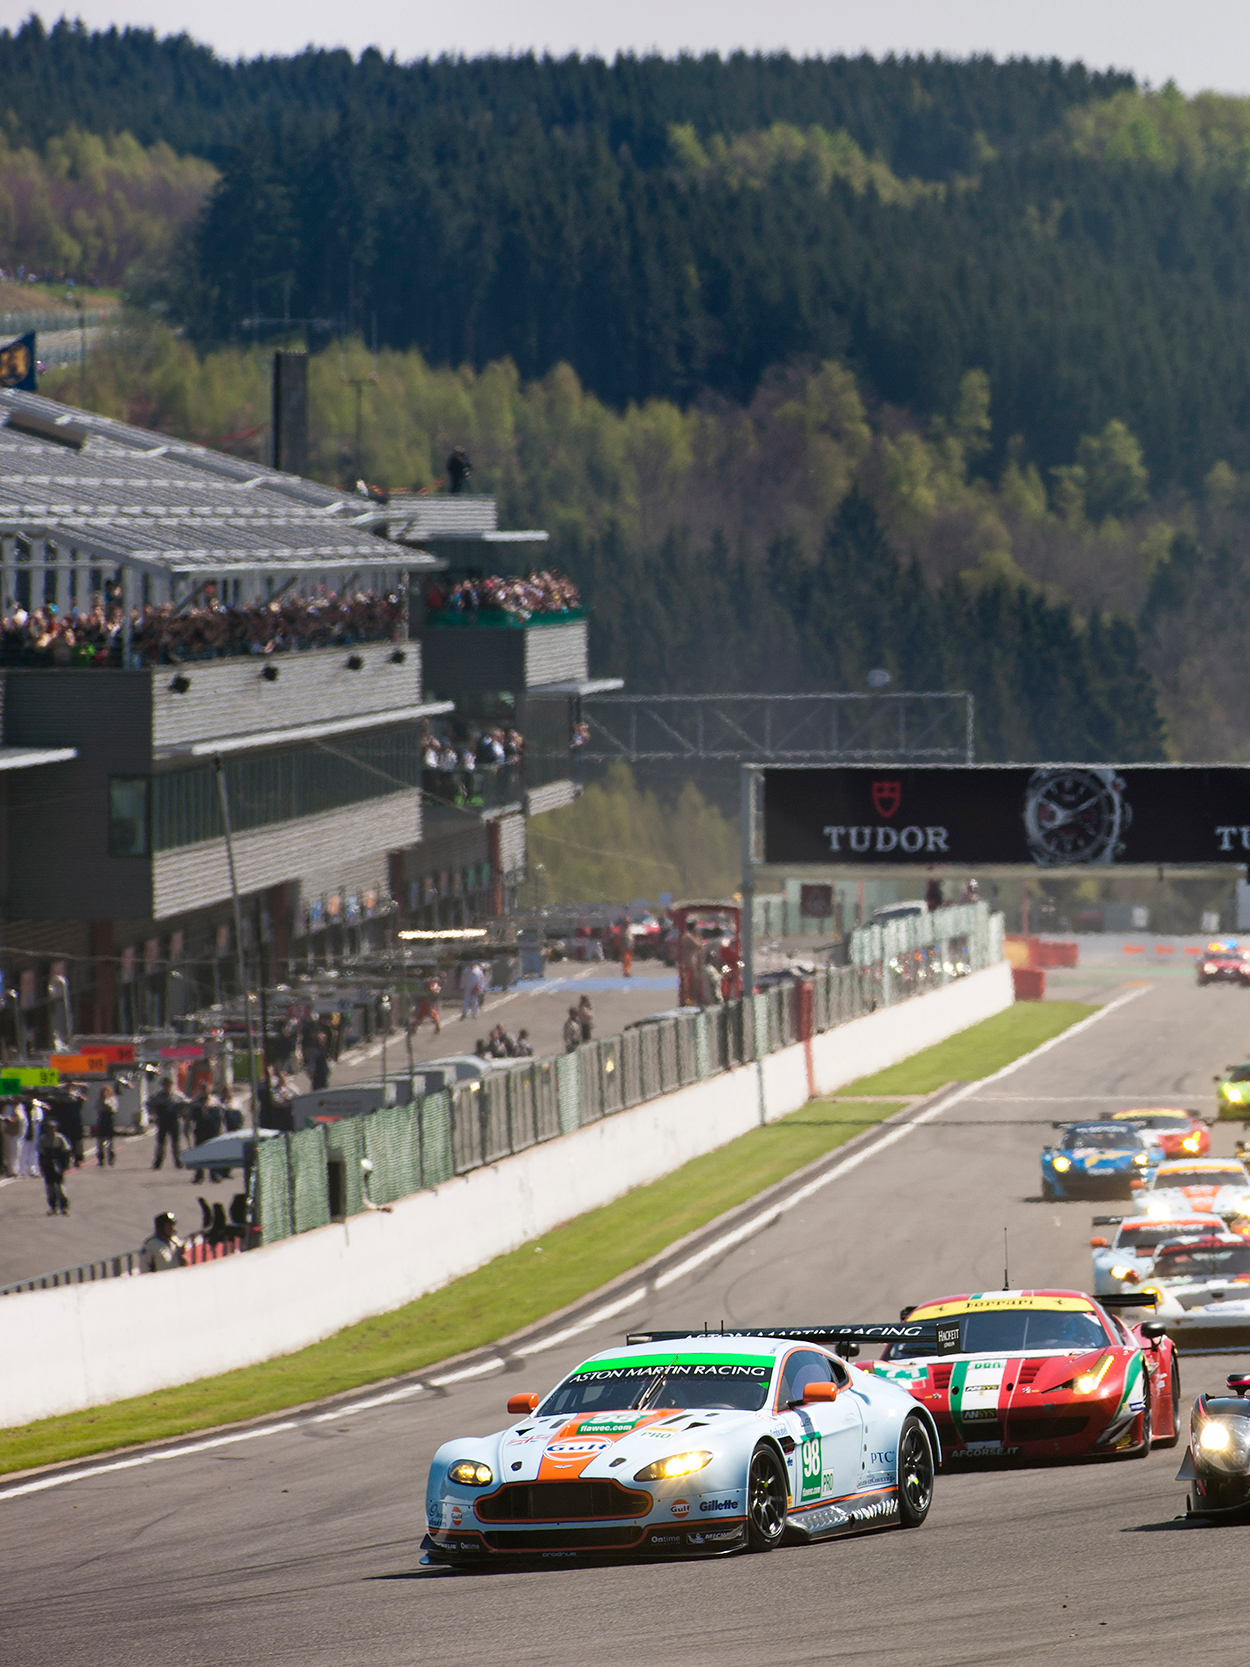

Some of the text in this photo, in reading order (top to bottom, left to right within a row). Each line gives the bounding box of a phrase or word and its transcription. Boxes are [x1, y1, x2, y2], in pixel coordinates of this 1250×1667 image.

[823, 825, 949, 854] TUDOR
[938, 1329, 959, 1342] HACKETT
[569, 1365, 766, 1384] ASTON MARTIN RACING
[964, 1409, 996, 1419] ANSYS
[580, 1424, 632, 1432] fiawec.com
[640, 1431, 672, 1439] PRO
[547, 1443, 611, 1451] Gulf
[952, 1446, 1019, 1458] AFCORSE.IT
[802, 1438, 821, 1478] 98
[871, 1452, 893, 1464] PTC
[823, 1473, 834, 1492] PRO
[670, 1504, 690, 1513] Gulf
[699, 1500, 738, 1512] Gillette
